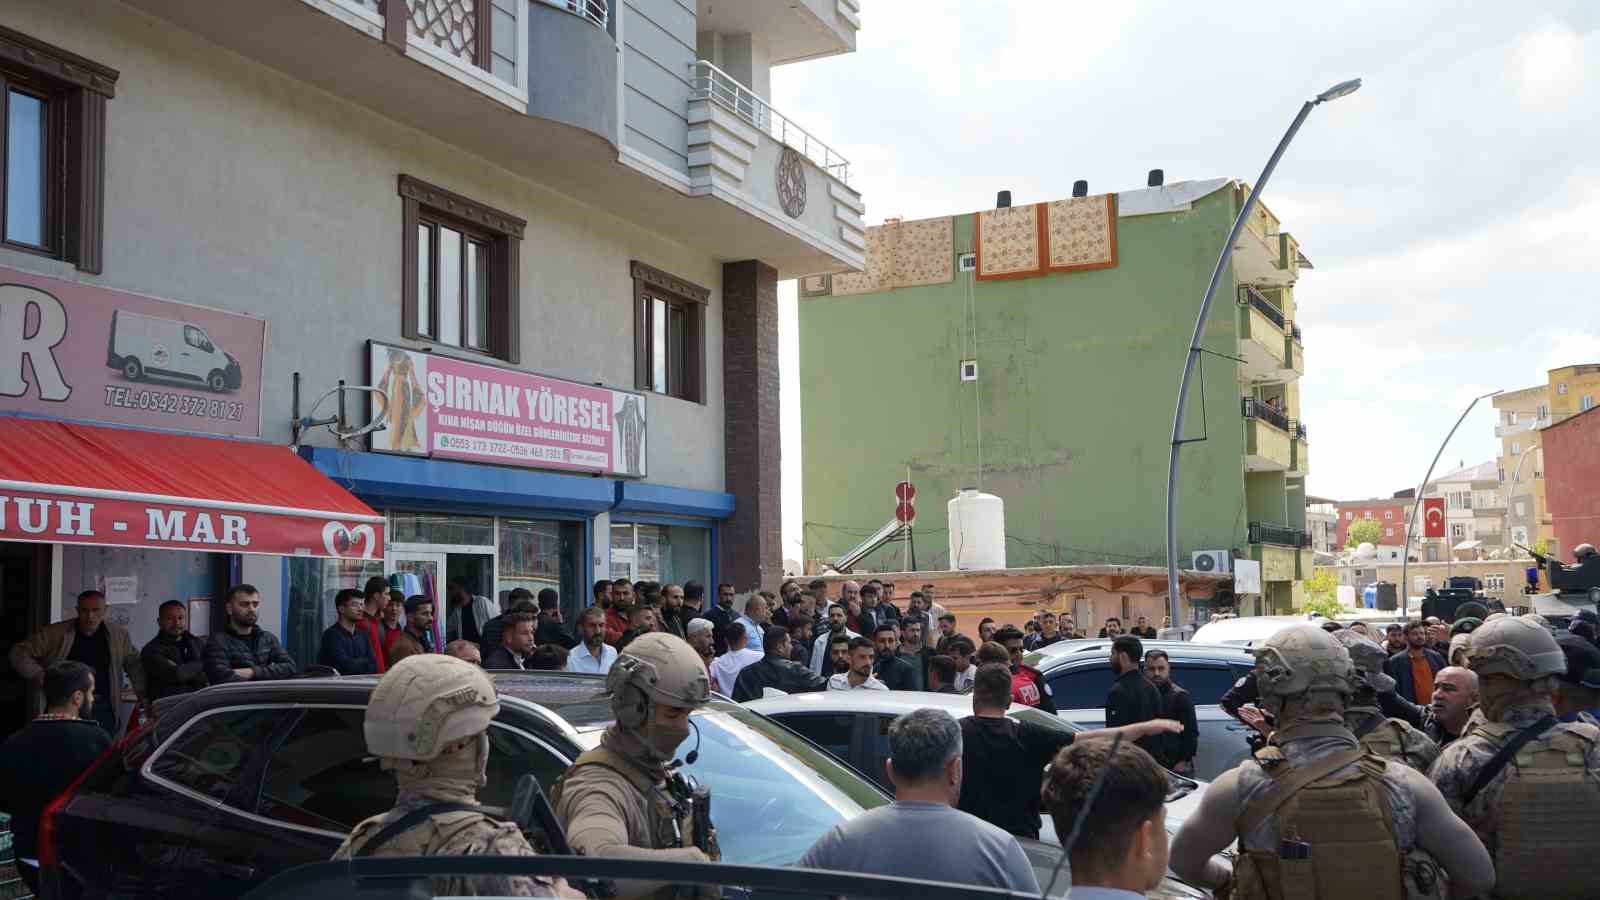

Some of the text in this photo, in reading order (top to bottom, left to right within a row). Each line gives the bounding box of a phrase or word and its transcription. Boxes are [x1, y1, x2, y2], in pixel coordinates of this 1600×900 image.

[0, 283, 72, 402] R
[181, 395, 207, 416] 372
[209, 400, 226, 418] 81
[227, 402, 243, 421] 21
[427, 371, 611, 432] ŞIRNAK YÖRESEL
[0, 495, 95, 536] UH
[145, 508, 250, 546] MAR
